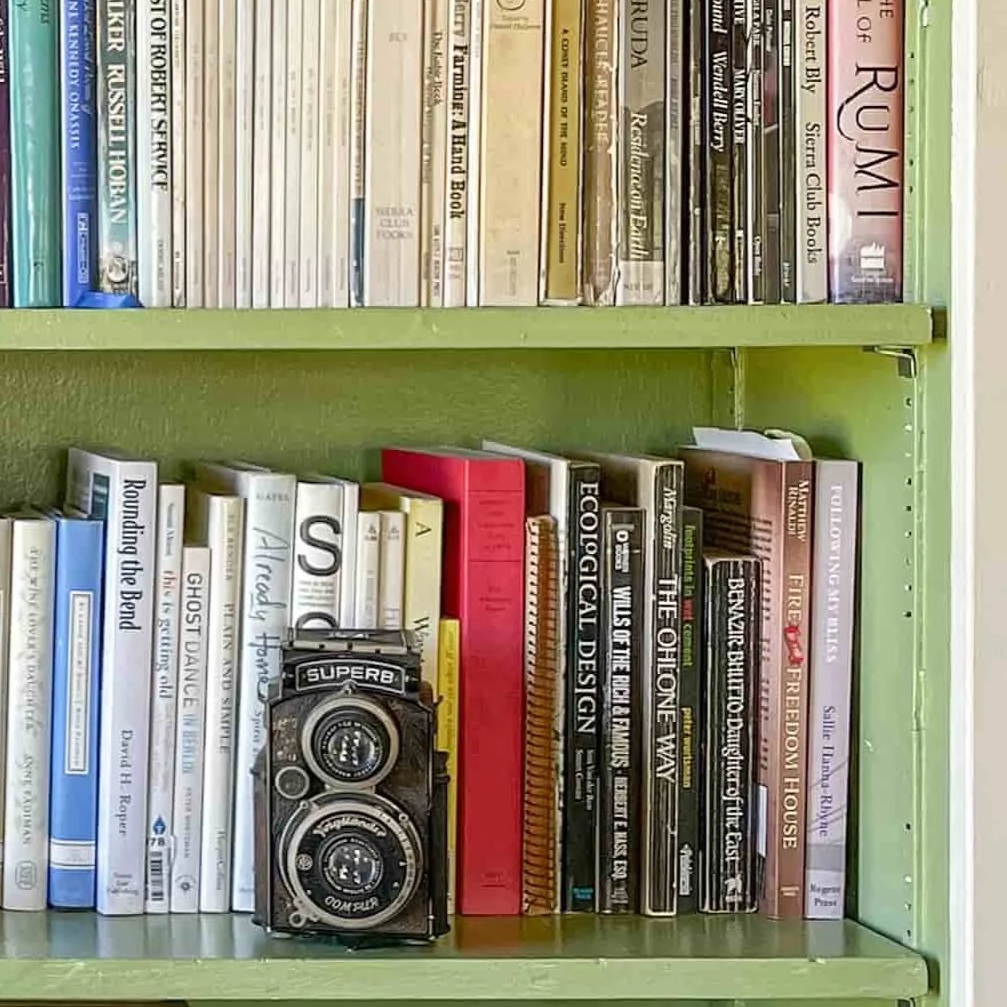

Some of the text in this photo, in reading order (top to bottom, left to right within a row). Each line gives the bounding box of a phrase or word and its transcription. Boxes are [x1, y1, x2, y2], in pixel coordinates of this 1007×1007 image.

[68, 25, 80, 85] KENNEDY
[150, 17, 168, 42] OF
[805, 5, 822, 63] Robert
[107, 64, 127, 145] RUSSELL
[150, 44, 168, 113] ROBERT
[711, 51, 729, 109] Wendell
[801, 67, 823, 94] Bly
[69, 92, 81, 149] ONASSIS
[451, 120, 467, 131] A
[709, 112, 729, 152] Berry
[805, 122, 822, 169] Sierra
[837, 64, 900, 217] RUMI
[150, 116, 170, 192] SERVICE
[450, 134, 467, 176] Hand
[107, 150, 128, 225] HOBAN
[449, 180, 466, 220] Book
[805, 174, 823, 212] Club
[806, 217, 824, 264] Books
[787, 486, 798, 535] RINALDI
[797, 480, 809, 543] MATTHEW
[297, 515, 342, 577] S
[574, 481, 599, 733] ECOLOGICAL DESIGN
[655, 487, 678, 784] Margolin THE OHLONE WAY
[726, 577, 745, 645] BENAZIR
[116, 479, 147, 836] Rounding the Bend David H. Roper
[305, 665, 395, 685] SUPERB
[680, 524, 695, 788] footprints in wet cement peter wortsman
[818, 485, 844, 837] FOLLOWING MY BLISS Sallie Hanna-Rhyne
[782, 574, 805, 850] FIRE FREEDOM HOUSE
[721, 718, 744, 786] Daughter
[722, 787, 744, 803] of
[725, 805, 744, 829] the
[725, 832, 744, 862] East
[324, 895, 380, 913] COMPUR
[814, 897, 837, 907] Press
